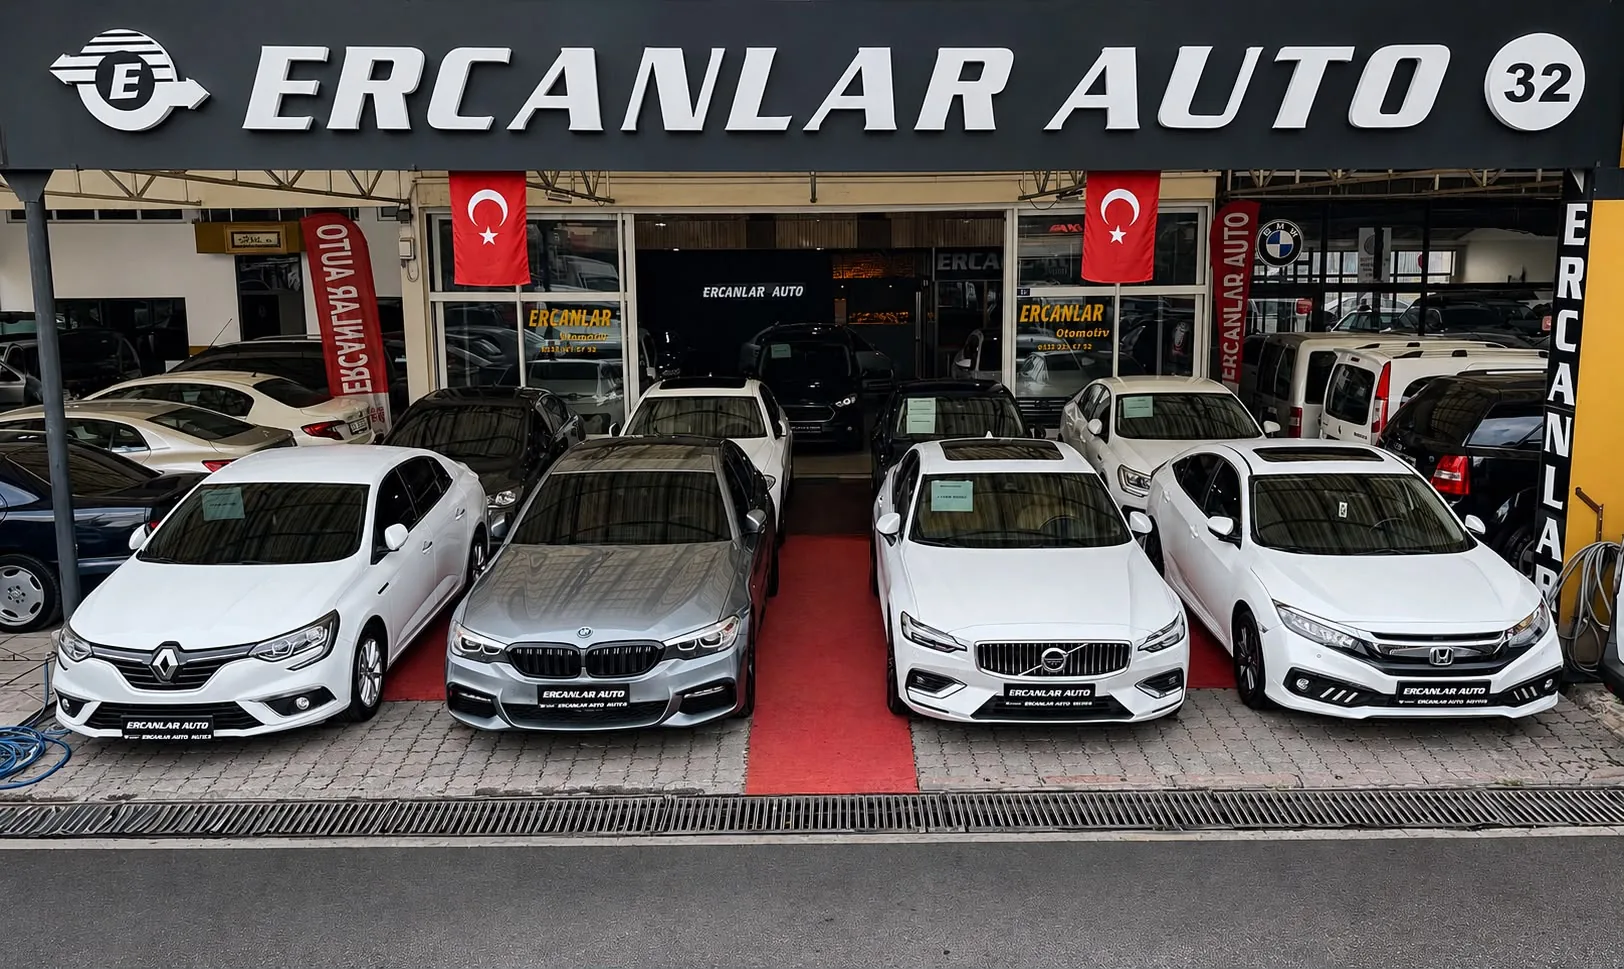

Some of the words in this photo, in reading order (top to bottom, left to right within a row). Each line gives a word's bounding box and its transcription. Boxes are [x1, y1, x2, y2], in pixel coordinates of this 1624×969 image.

[109, 62, 142, 100] E
[242, 45, 1015, 132] ERCANLAR
[1044, 44, 1451, 131] AUTO
[1503, 62, 1572, 103] 32
[1223, 212, 1250, 267] AUTO
[936, 252, 1004, 271] ERCA
[702, 286, 766, 298] ERCANLAR
[771, 285, 804, 297] AUTO
[528, 308, 612, 327] ERCANLAR
[1019, 303, 1104, 322] ERCANLAR
[1056, 327, 1110, 338] Otomotiv
[1222, 272, 1244, 384] ERCANLAR
[1535, 203, 1588, 612] ERCANLAR
[543, 690, 596, 698] ERCANLAR
[597, 690, 625, 698] AUTO
[1009, 689, 1062, 697] ERCANLAR
[1063, 689, 1091, 697] AUTO
[1403, 687, 1456, 696] ERCANLAR
[1457, 687, 1486, 695] AUTO
[126, 721, 181, 730] ERCANLAR
[181, 721, 209, 730] AUTO
